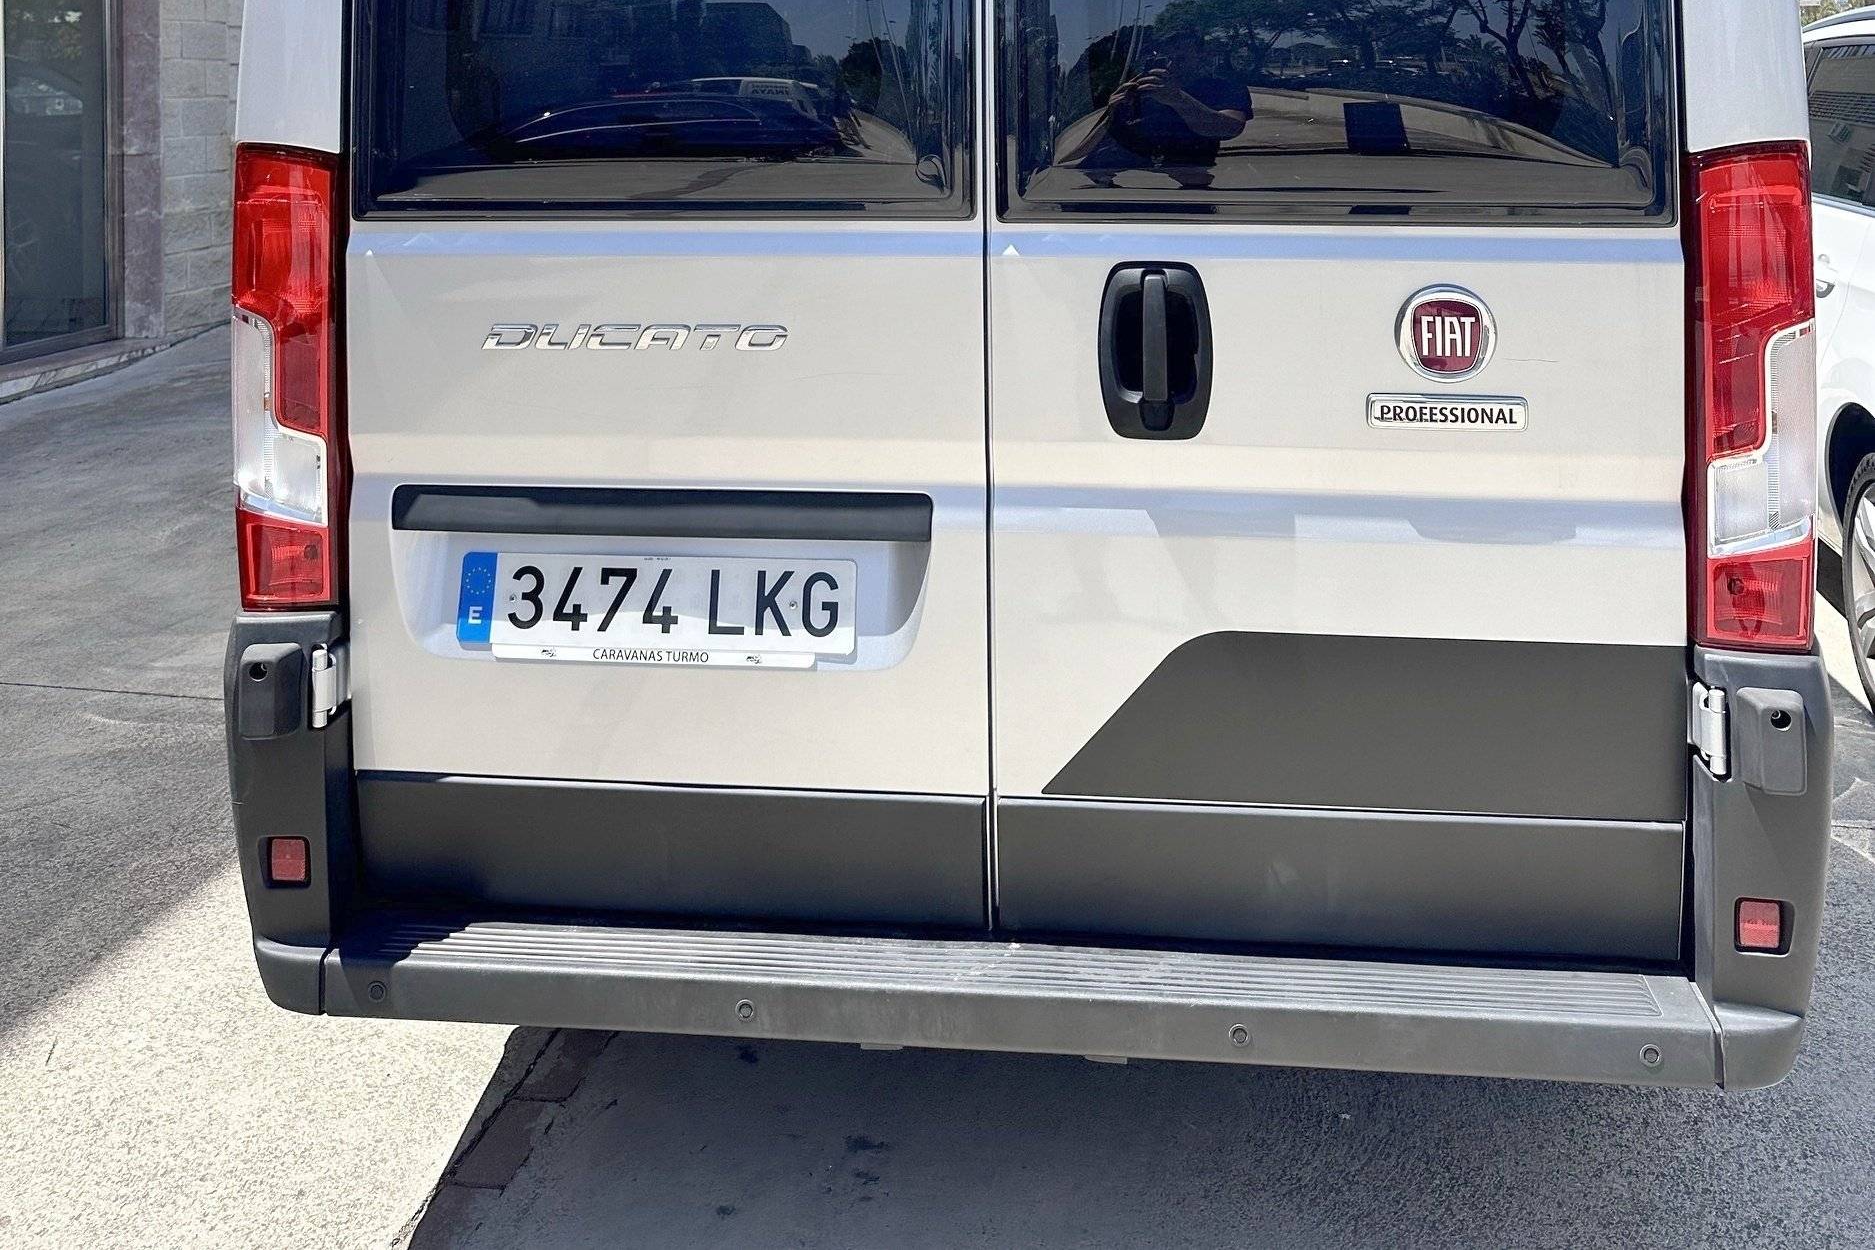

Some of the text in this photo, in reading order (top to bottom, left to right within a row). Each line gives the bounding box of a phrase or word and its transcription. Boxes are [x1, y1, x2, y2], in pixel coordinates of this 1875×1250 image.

[480, 323, 789, 351] DUCATO
[1420, 315, 1476, 358] FIAT
[1379, 404, 1518, 425] PROFESSIONAL
[507, 565, 840, 638] 3474 LKG
[467, 605, 483, 625] E
[592, 648, 709, 663] CARAVANAS TURMO
